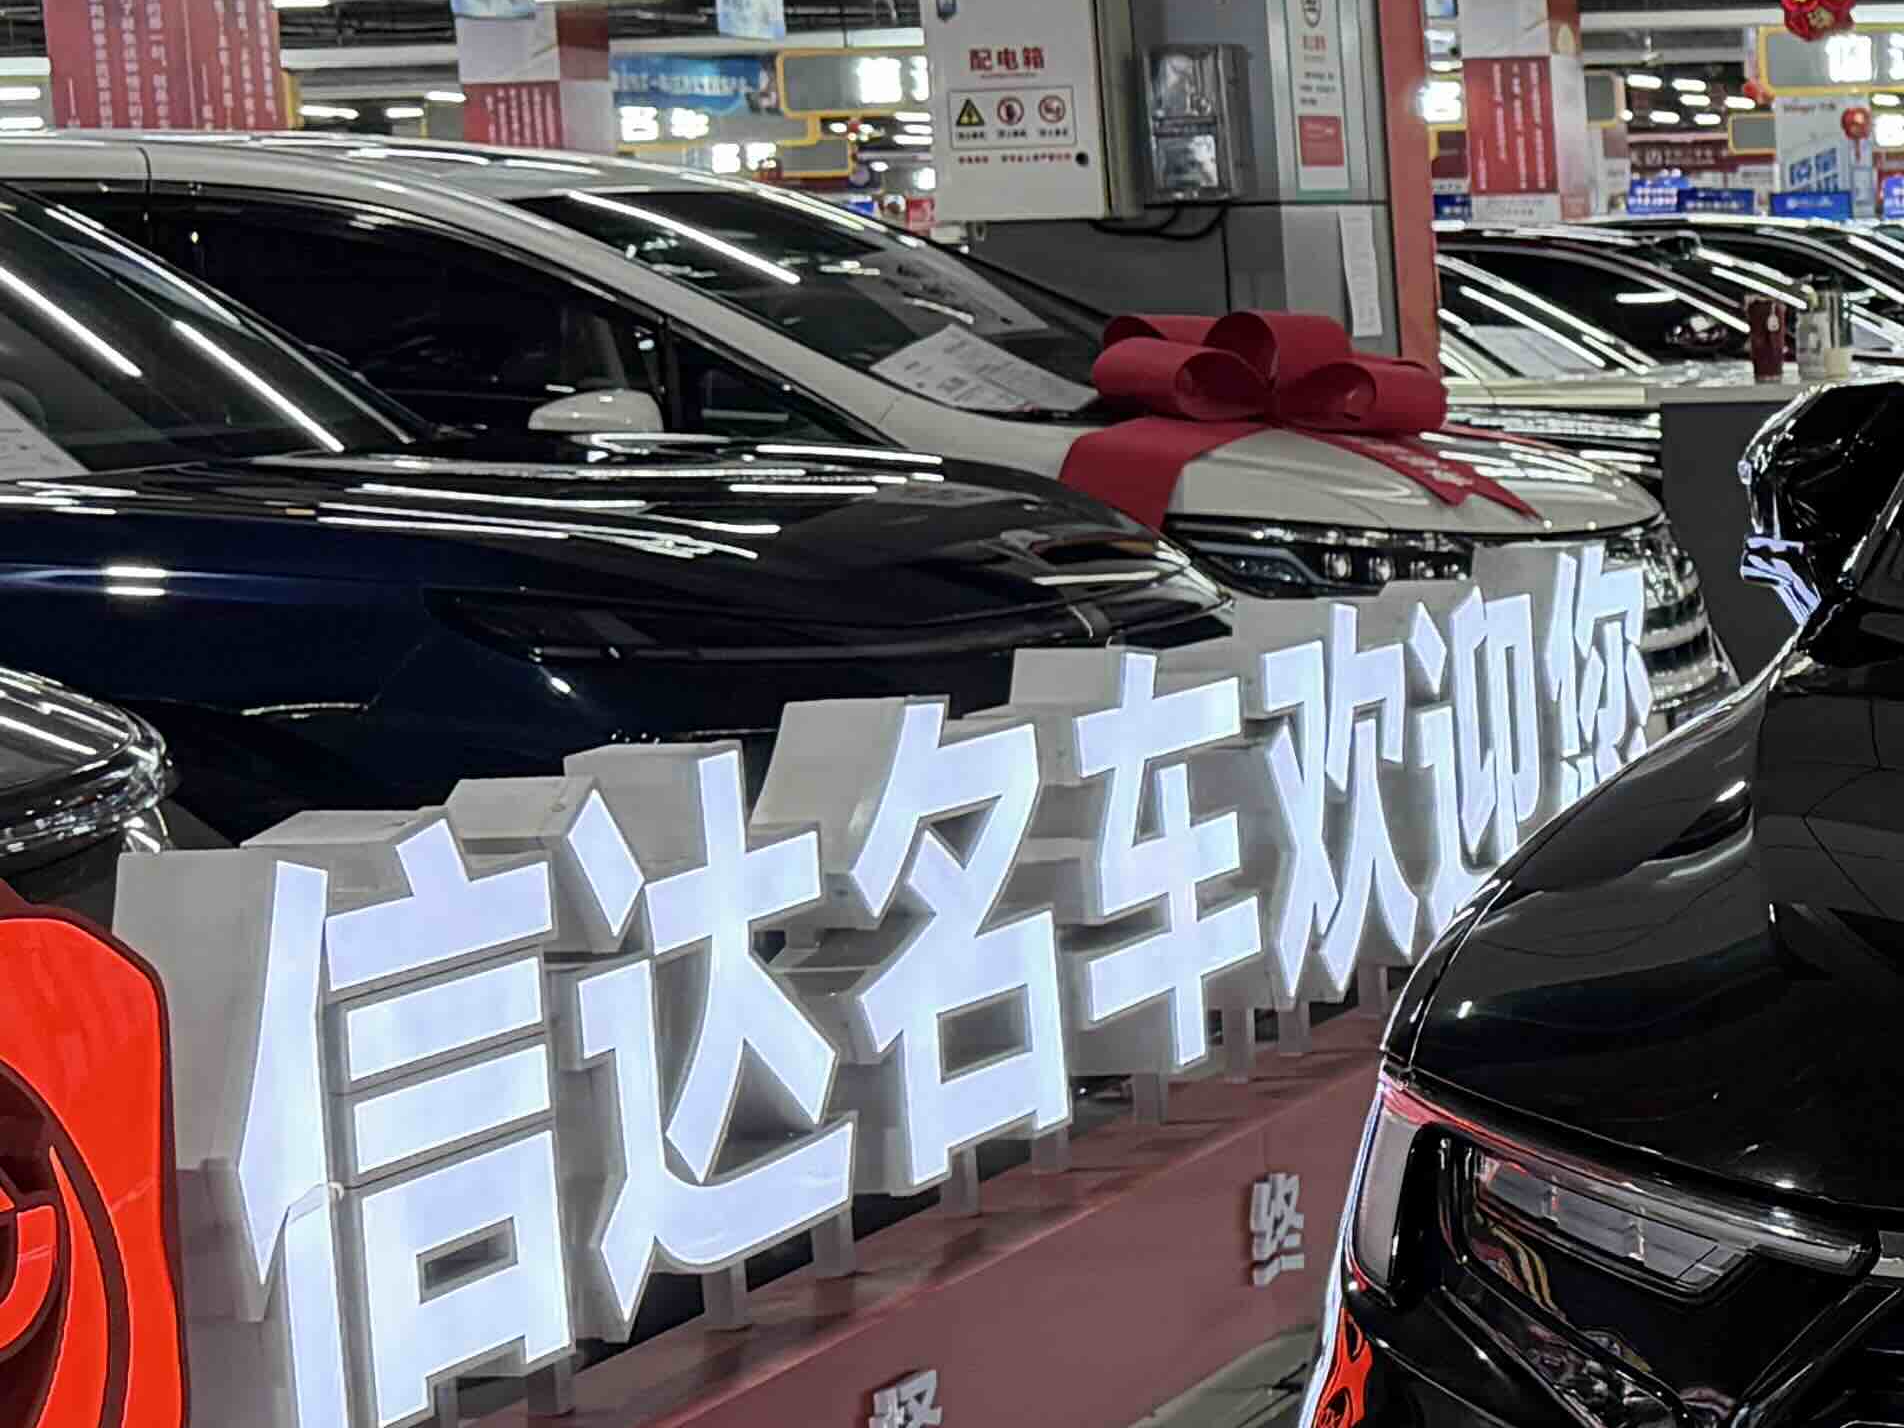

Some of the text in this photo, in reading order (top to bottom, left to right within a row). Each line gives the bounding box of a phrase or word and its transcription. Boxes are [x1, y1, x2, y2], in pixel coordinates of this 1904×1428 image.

[968, 46, 1045, 71] 配电箱
[1250, 1170, 1307, 1286] 终
